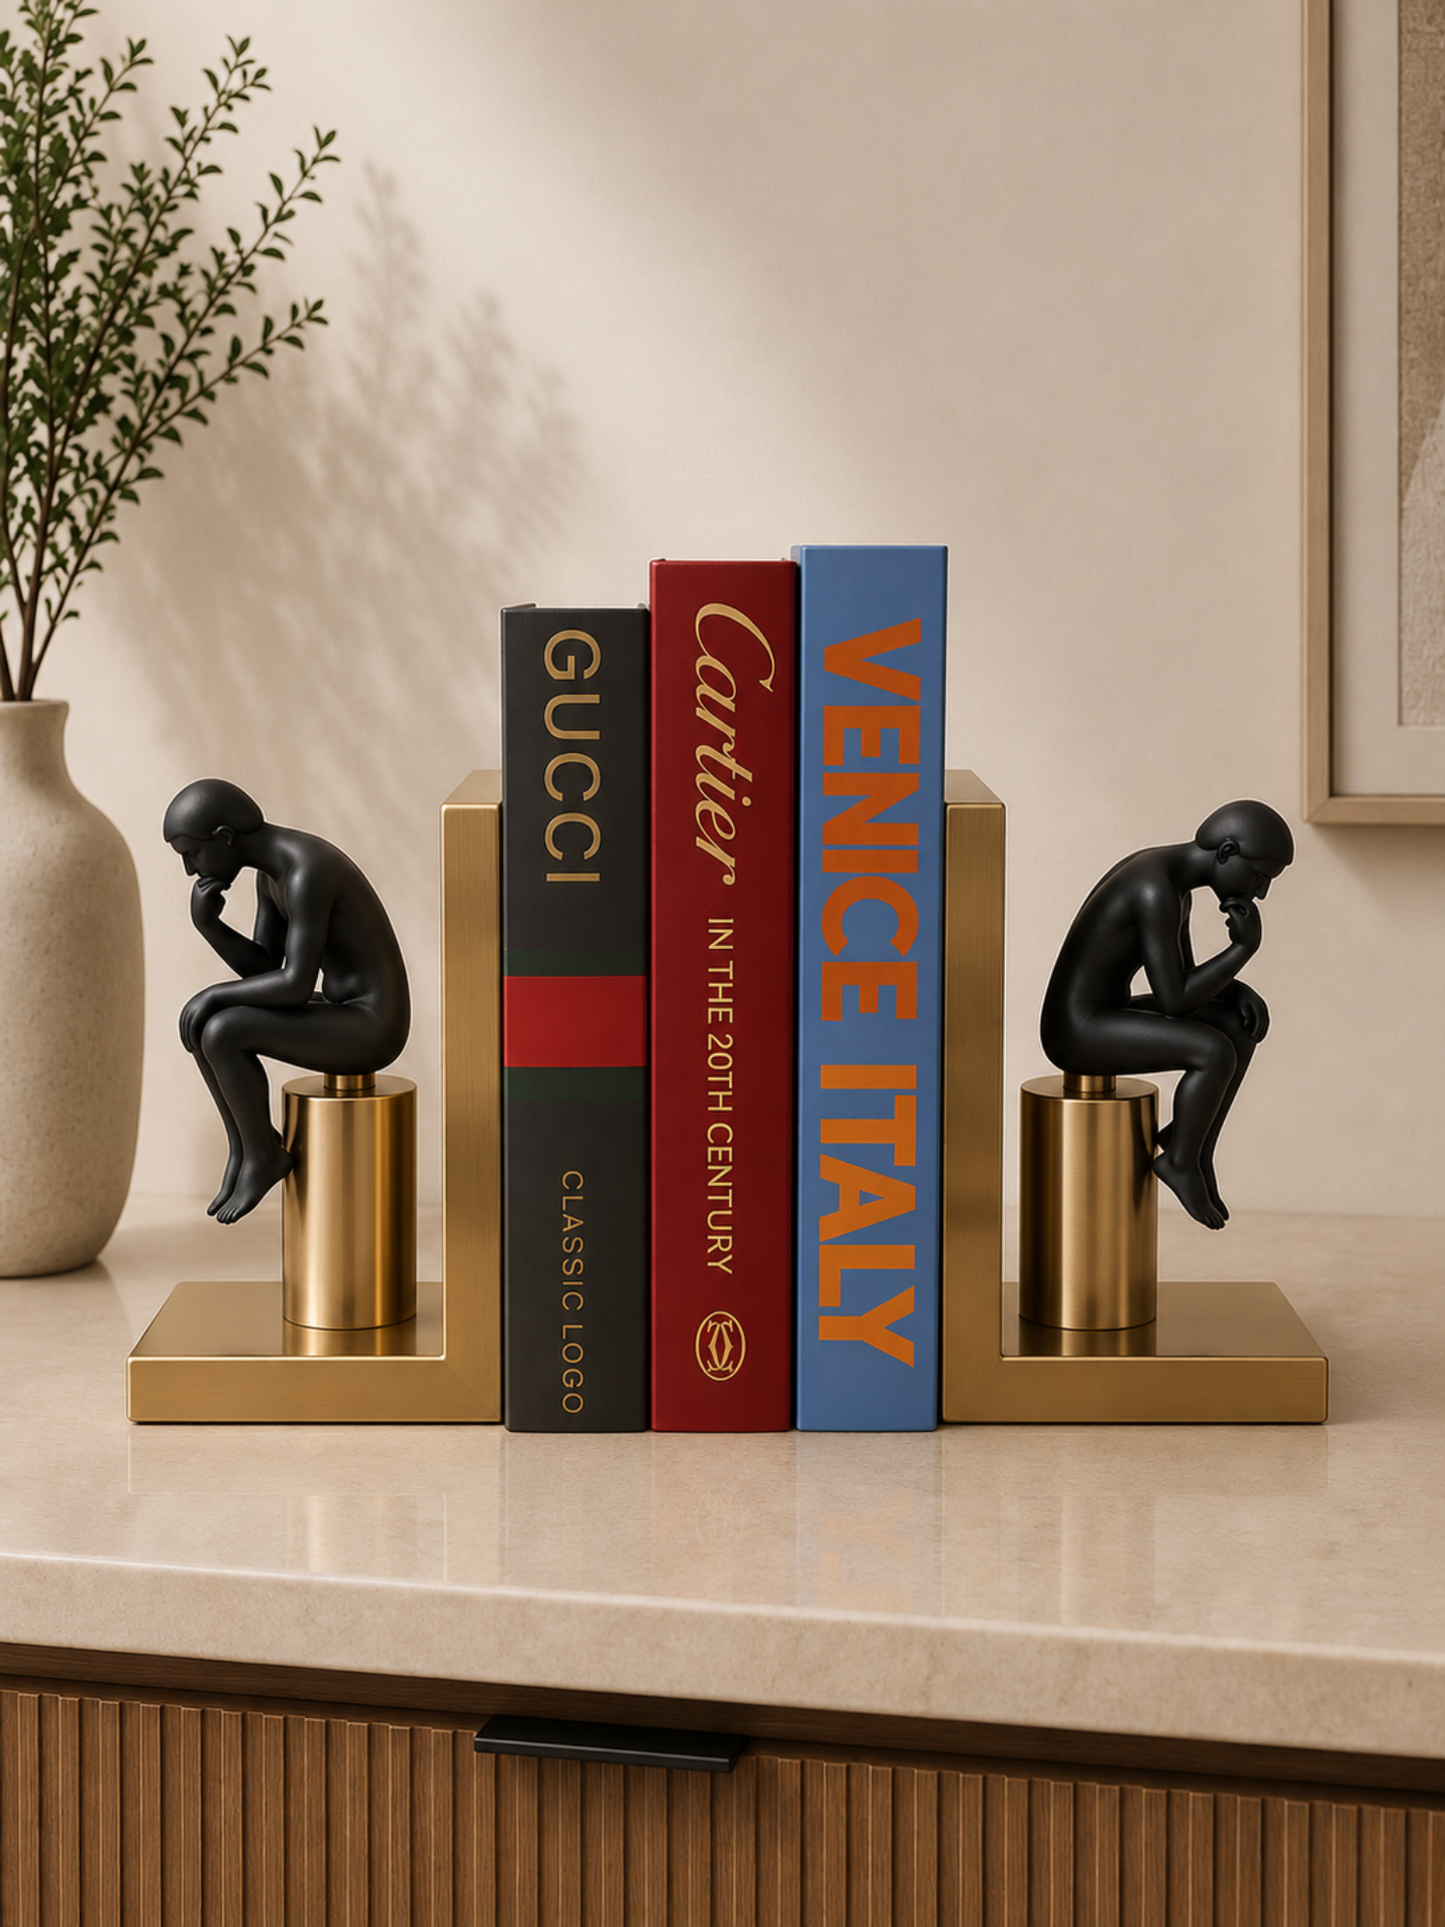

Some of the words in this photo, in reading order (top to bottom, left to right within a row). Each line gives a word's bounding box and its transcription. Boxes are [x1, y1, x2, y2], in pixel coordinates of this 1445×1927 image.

[543, 629, 602, 882] GUCCI
[694, 602, 776, 886] Cartier
[820, 617, 922, 1022] VENICE
[707, 918, 734, 950] IN
[707, 960, 734, 1024] THE
[707, 1033, 734, 1111] 20TH
[561, 1170, 584, 1311] CLASSIC
[707, 1122, 733, 1275] CENTURY
[817, 1064, 918, 1368] ITALY
[561, 1324, 584, 1414] LOGO
